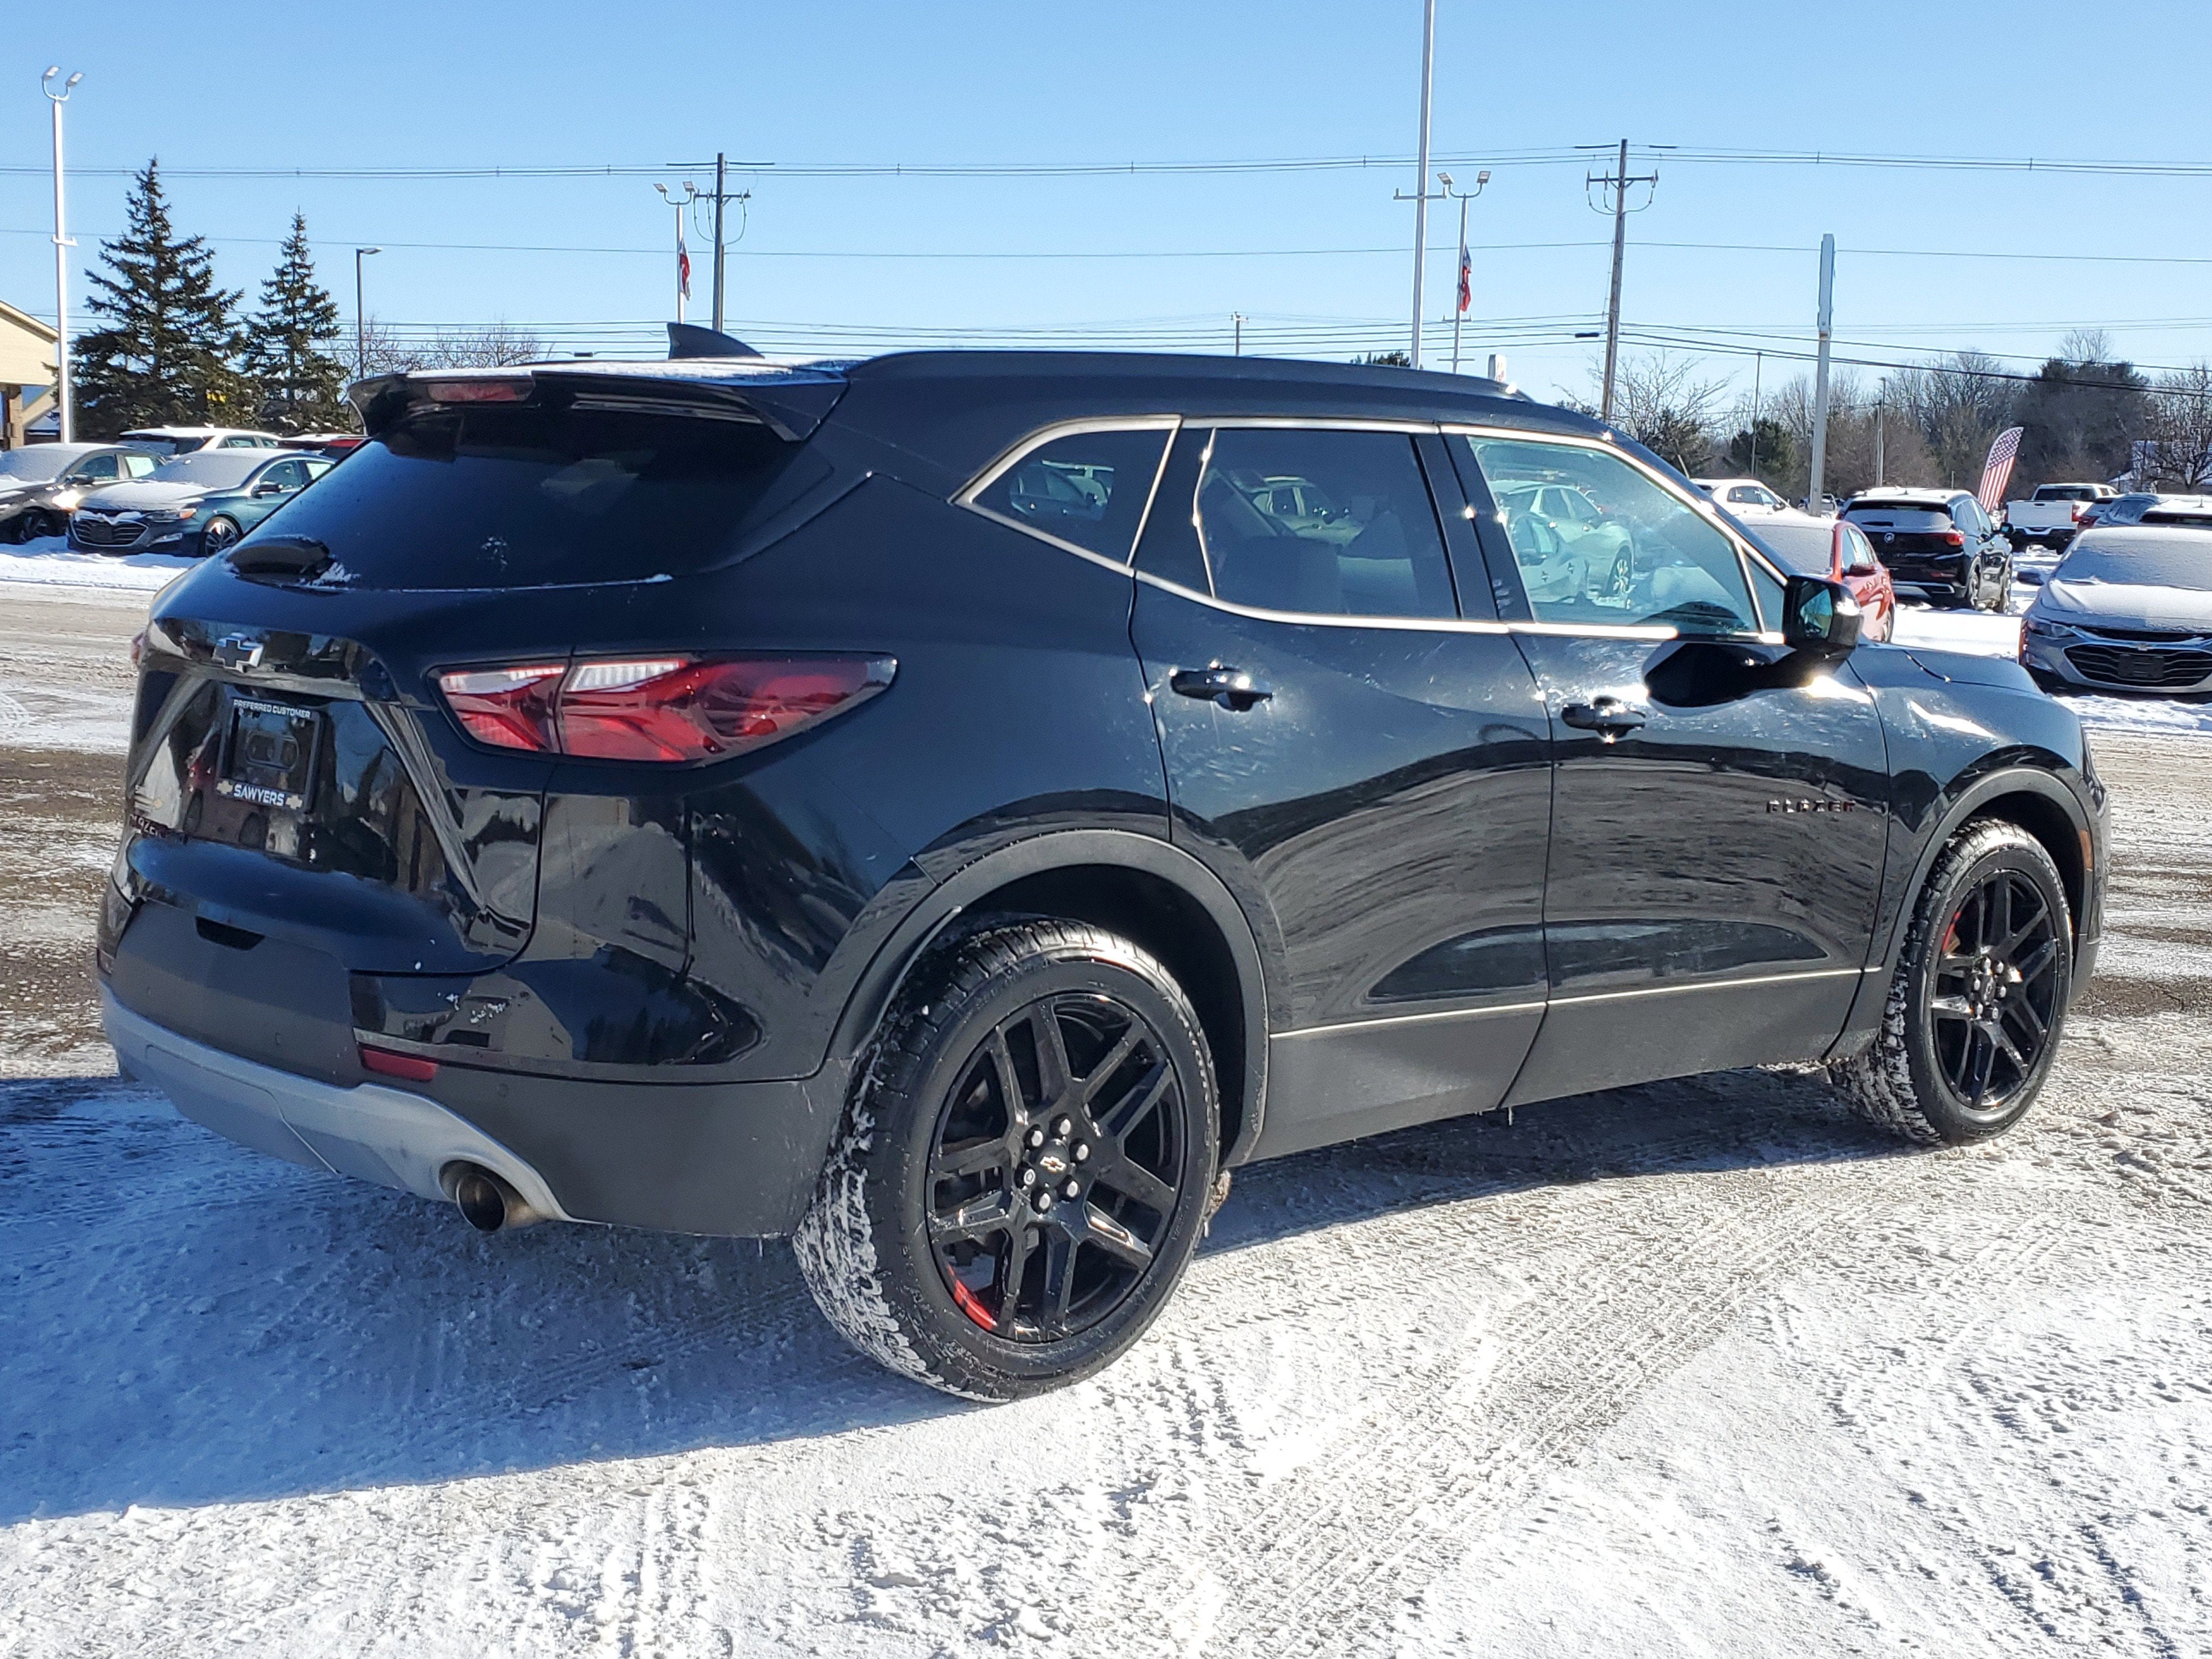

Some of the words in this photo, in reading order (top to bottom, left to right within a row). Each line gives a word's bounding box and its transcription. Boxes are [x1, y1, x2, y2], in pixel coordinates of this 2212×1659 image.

[233, 699, 272, 713] PREFERRED
[272, 706, 311, 718] CUSTOMER
[234, 783, 285, 806] SAWYERS
